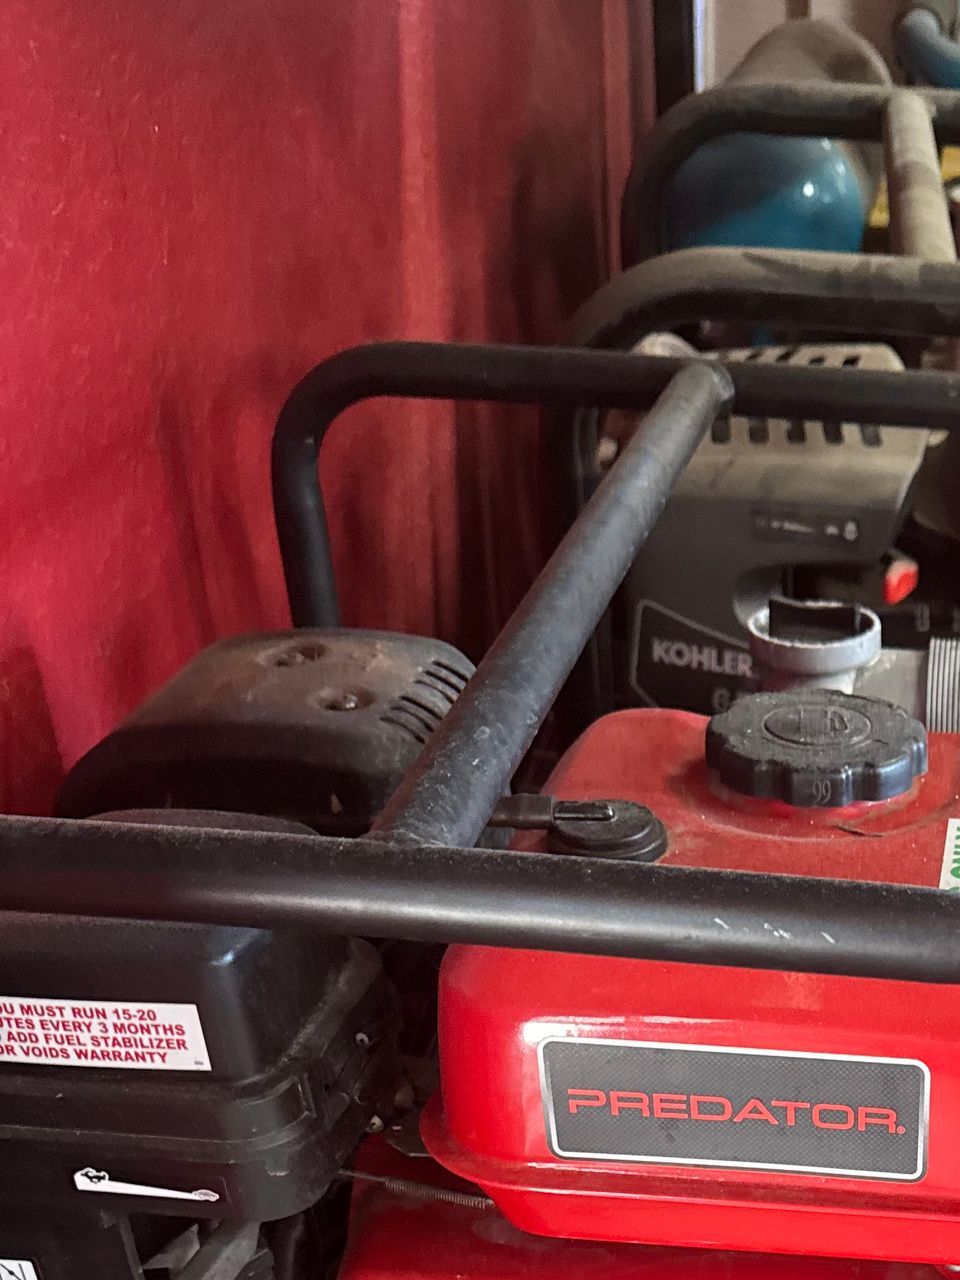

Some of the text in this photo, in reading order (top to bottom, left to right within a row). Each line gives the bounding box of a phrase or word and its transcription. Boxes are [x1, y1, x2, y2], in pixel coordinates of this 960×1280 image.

[652, 638, 753, 677] KOHLER
[20, 1004, 65, 1018] MUST
[72, 1007, 107, 1019] RUN
[113, 1009, 156, 1021] 15-20
[40, 1019, 93, 1033] EVERY
[100, 1022, 109, 1034] 3
[113, 1023, 186, 1036] MONTHS
[7, 1031, 39, 1043] ADD
[44, 1034, 86, 1047] FUEL
[90, 1035, 188, 1050] STABILIZER
[19, 1045, 70, 1059] VOIDS
[75, 1047, 168, 1064] WARRANTY
